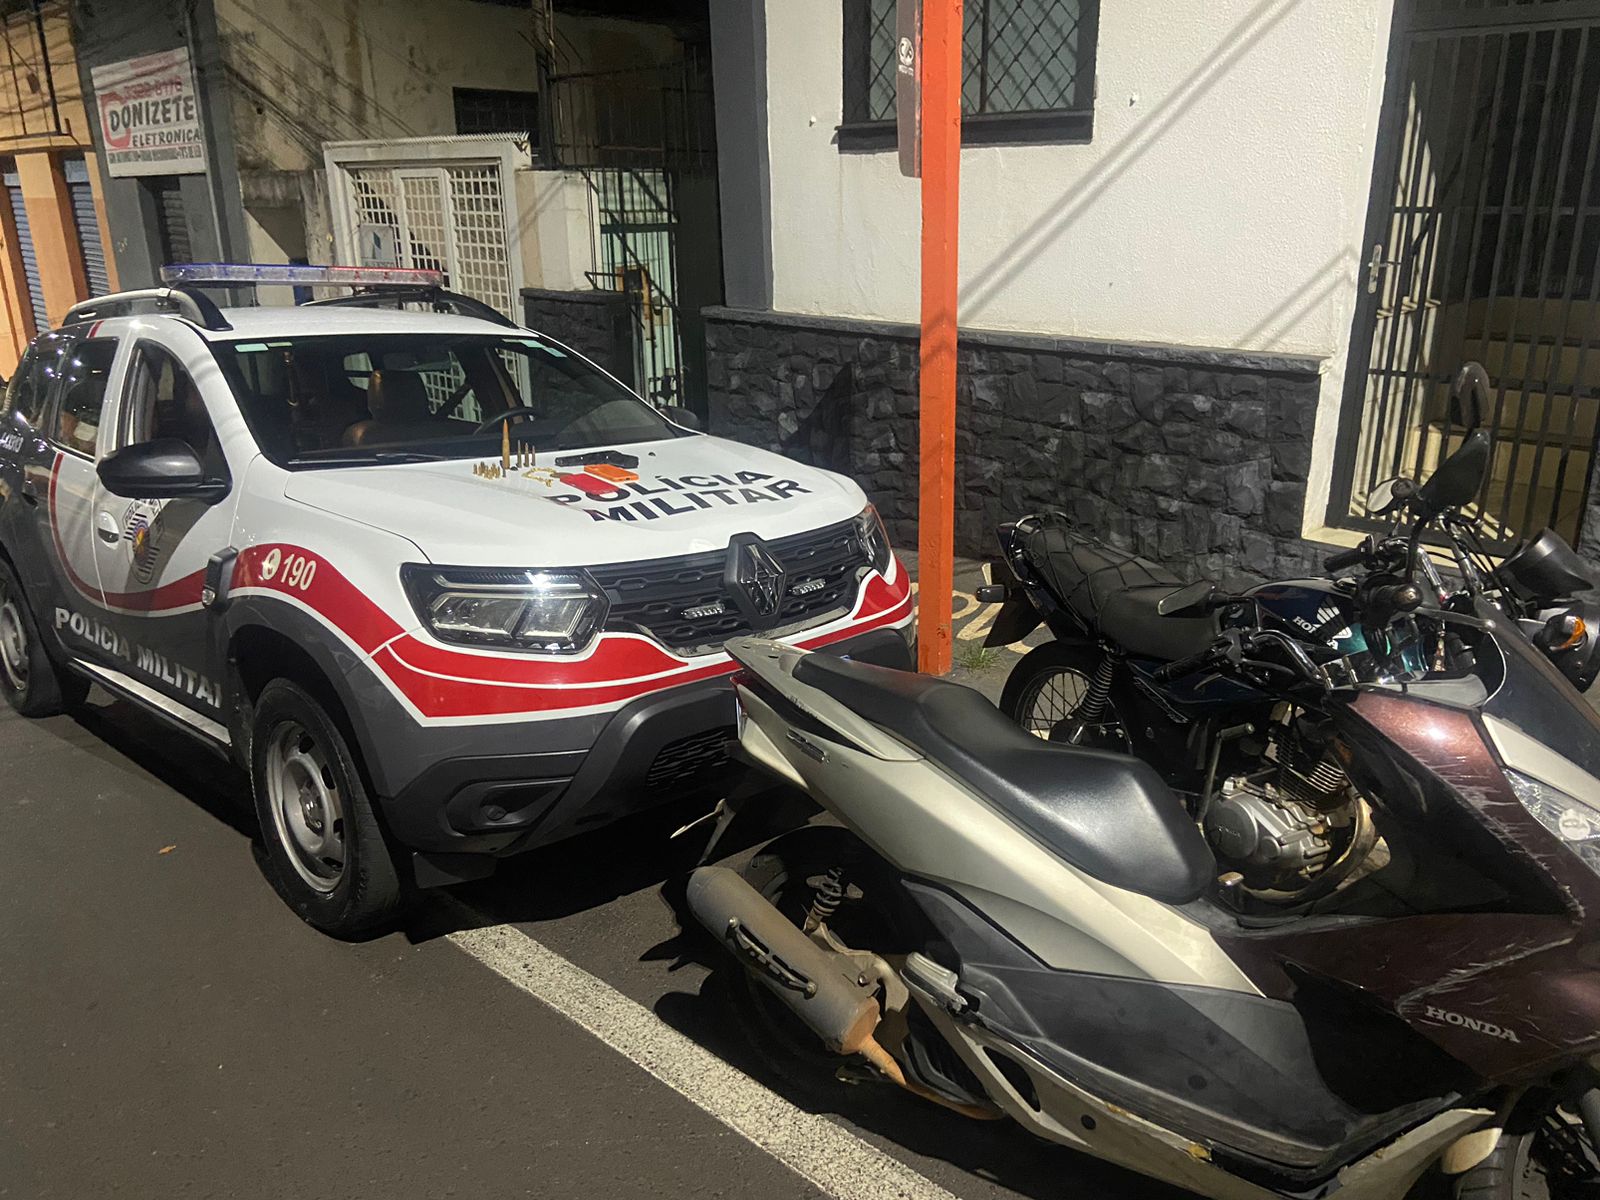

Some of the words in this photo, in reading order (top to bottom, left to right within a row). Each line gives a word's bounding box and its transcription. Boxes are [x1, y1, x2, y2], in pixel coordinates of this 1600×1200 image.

[109, 95, 195, 132] DONIZETE
[132, 128, 201, 147] ELETRONICA
[582, 480, 813, 522] MILITAR
[281, 554, 316, 590] 190
[1425, 1005, 1521, 1043] HONDA
